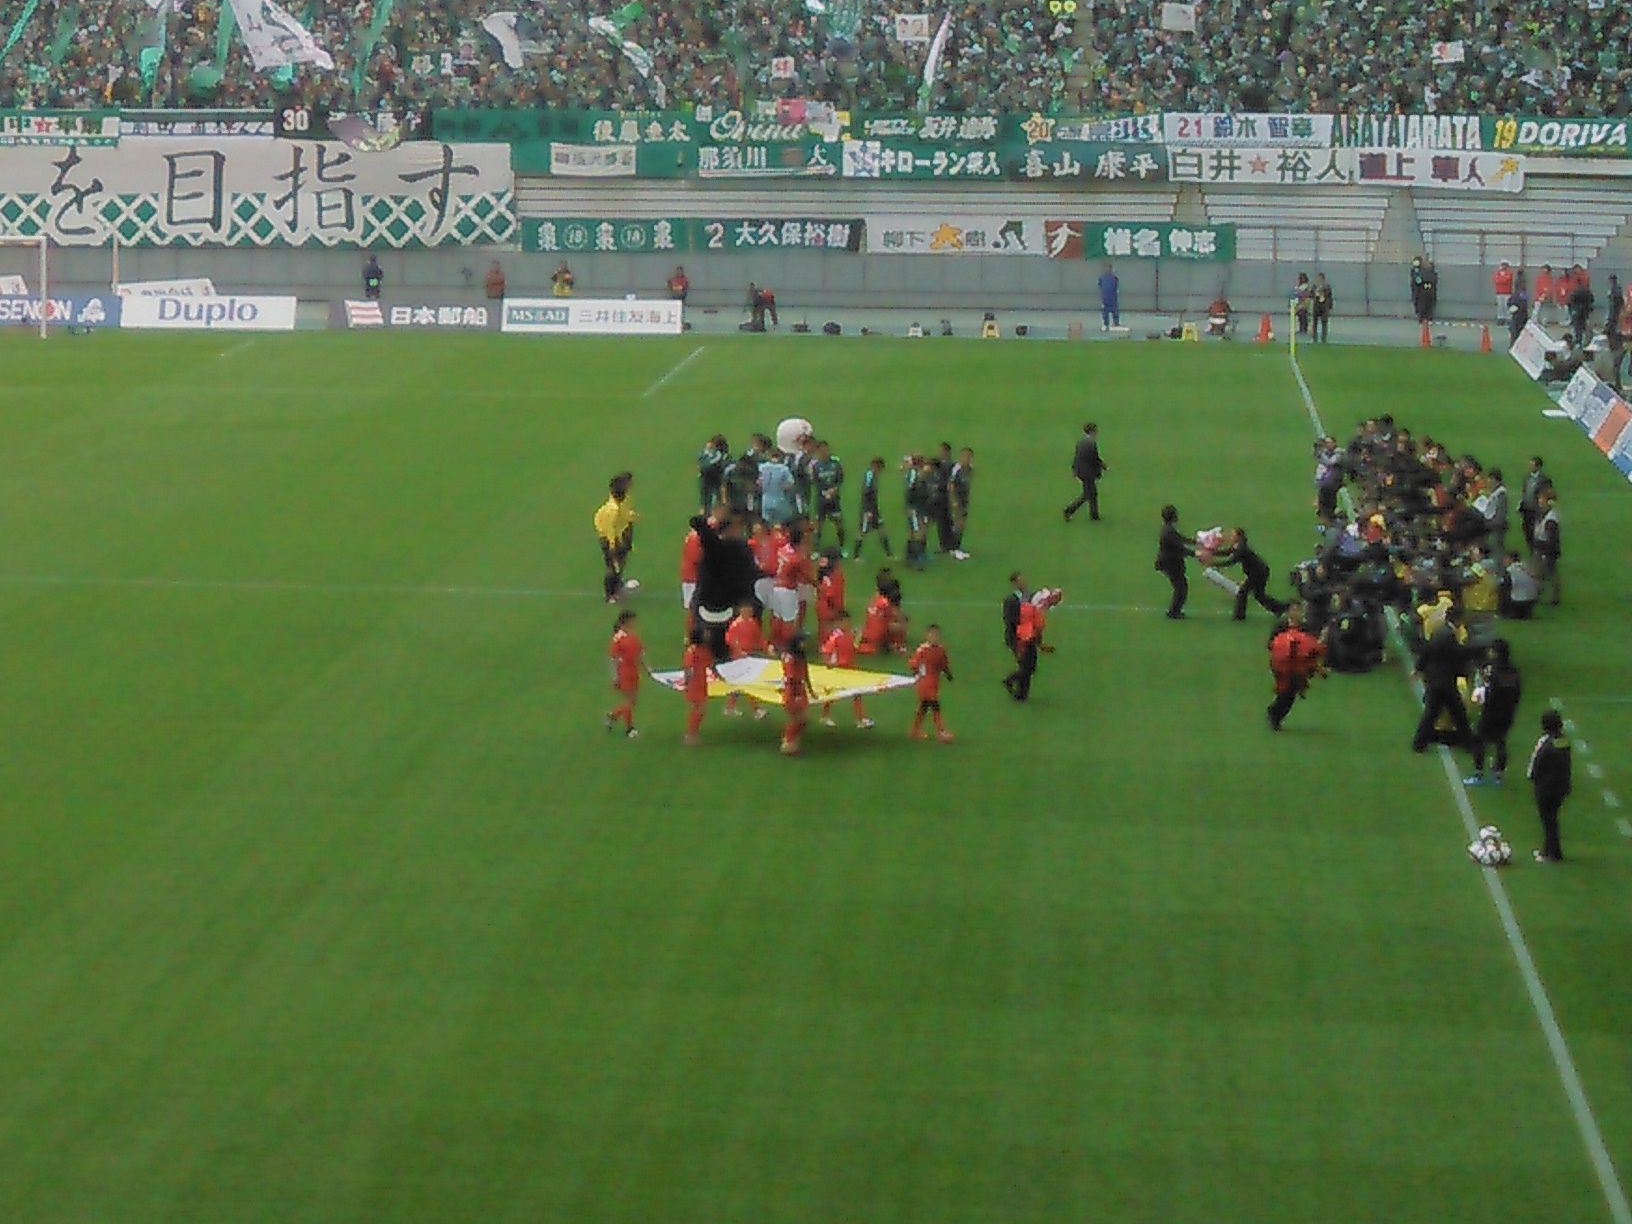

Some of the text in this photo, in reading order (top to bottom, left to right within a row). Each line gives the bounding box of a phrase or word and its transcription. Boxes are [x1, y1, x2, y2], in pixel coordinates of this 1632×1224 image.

[282, 108, 310, 132] 30
[1177, 116, 1202, 138] 21
[1493, 118, 1628, 150] 19 DORIVA
[704, 222, 724, 249] 2
[157, 298, 259, 325] Duplo
[390, 305, 488, 325] 日本郵船
